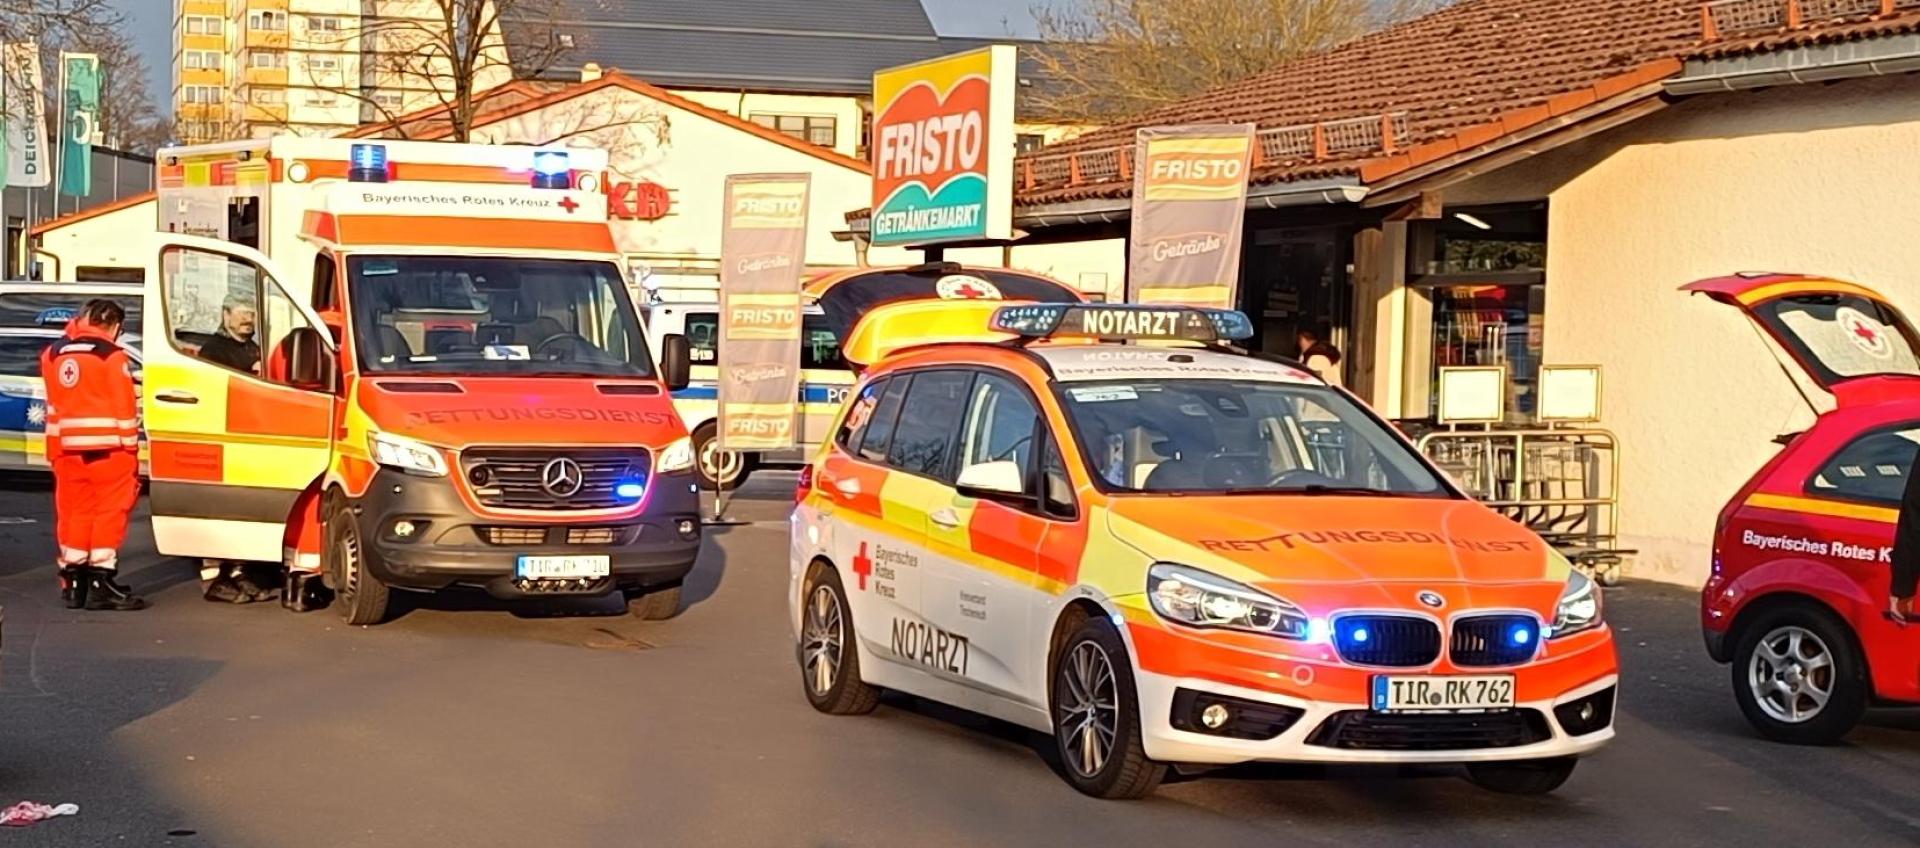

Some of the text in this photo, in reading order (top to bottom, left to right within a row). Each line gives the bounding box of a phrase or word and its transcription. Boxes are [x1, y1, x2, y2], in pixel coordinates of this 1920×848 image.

[877, 109, 983, 180] FRISTO
[1151, 159, 1241, 180] FRISTO
[362, 192, 551, 208] Bayerisches Rotes Kreuz
[876, 204, 982, 236] GETRÄNKEMARKT
[1153, 236, 1221, 262] Getränke
[731, 308, 796, 325] FRISTO
[1083, 310, 1181, 335] NOTARZT
[729, 418, 790, 433] FRISTO
[875, 544, 918, 567] Bayerisches
[1742, 529, 1828, 556] Bayerisches
[1831, 541, 1876, 561] Rotes
[875, 562, 895, 580] Rotes
[875, 581, 896, 599] Kreuz
[891, 617, 969, 675] NOTARZT
[1392, 680, 1512, 704] TIR RK 762
